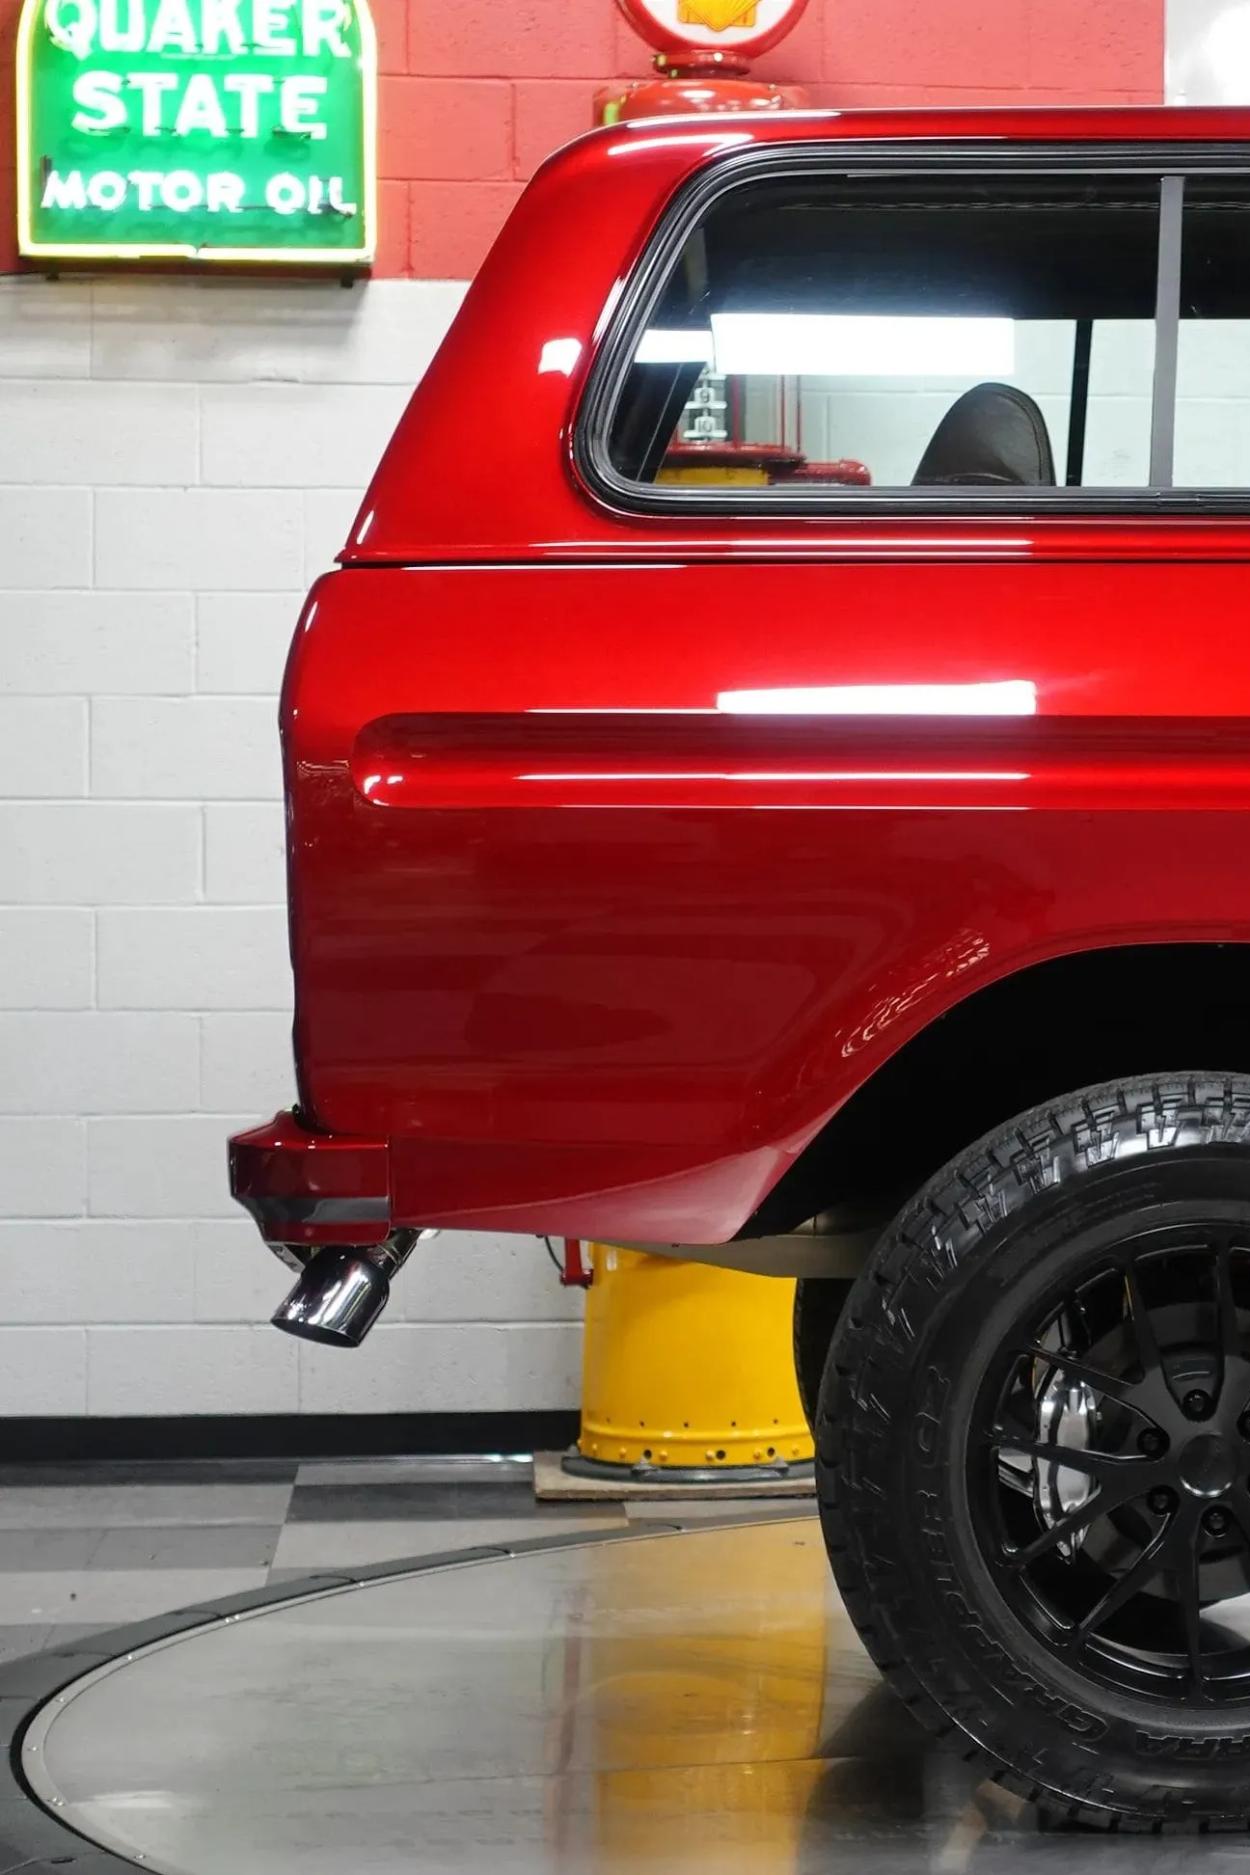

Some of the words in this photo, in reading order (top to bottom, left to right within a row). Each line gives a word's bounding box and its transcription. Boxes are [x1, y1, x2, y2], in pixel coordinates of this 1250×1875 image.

[44, 0, 351, 60] QUAKER
[71, 71, 327, 139] STATE
[41, 170, 245, 213] MOTOR
[265, 172, 357, 214] OIL
